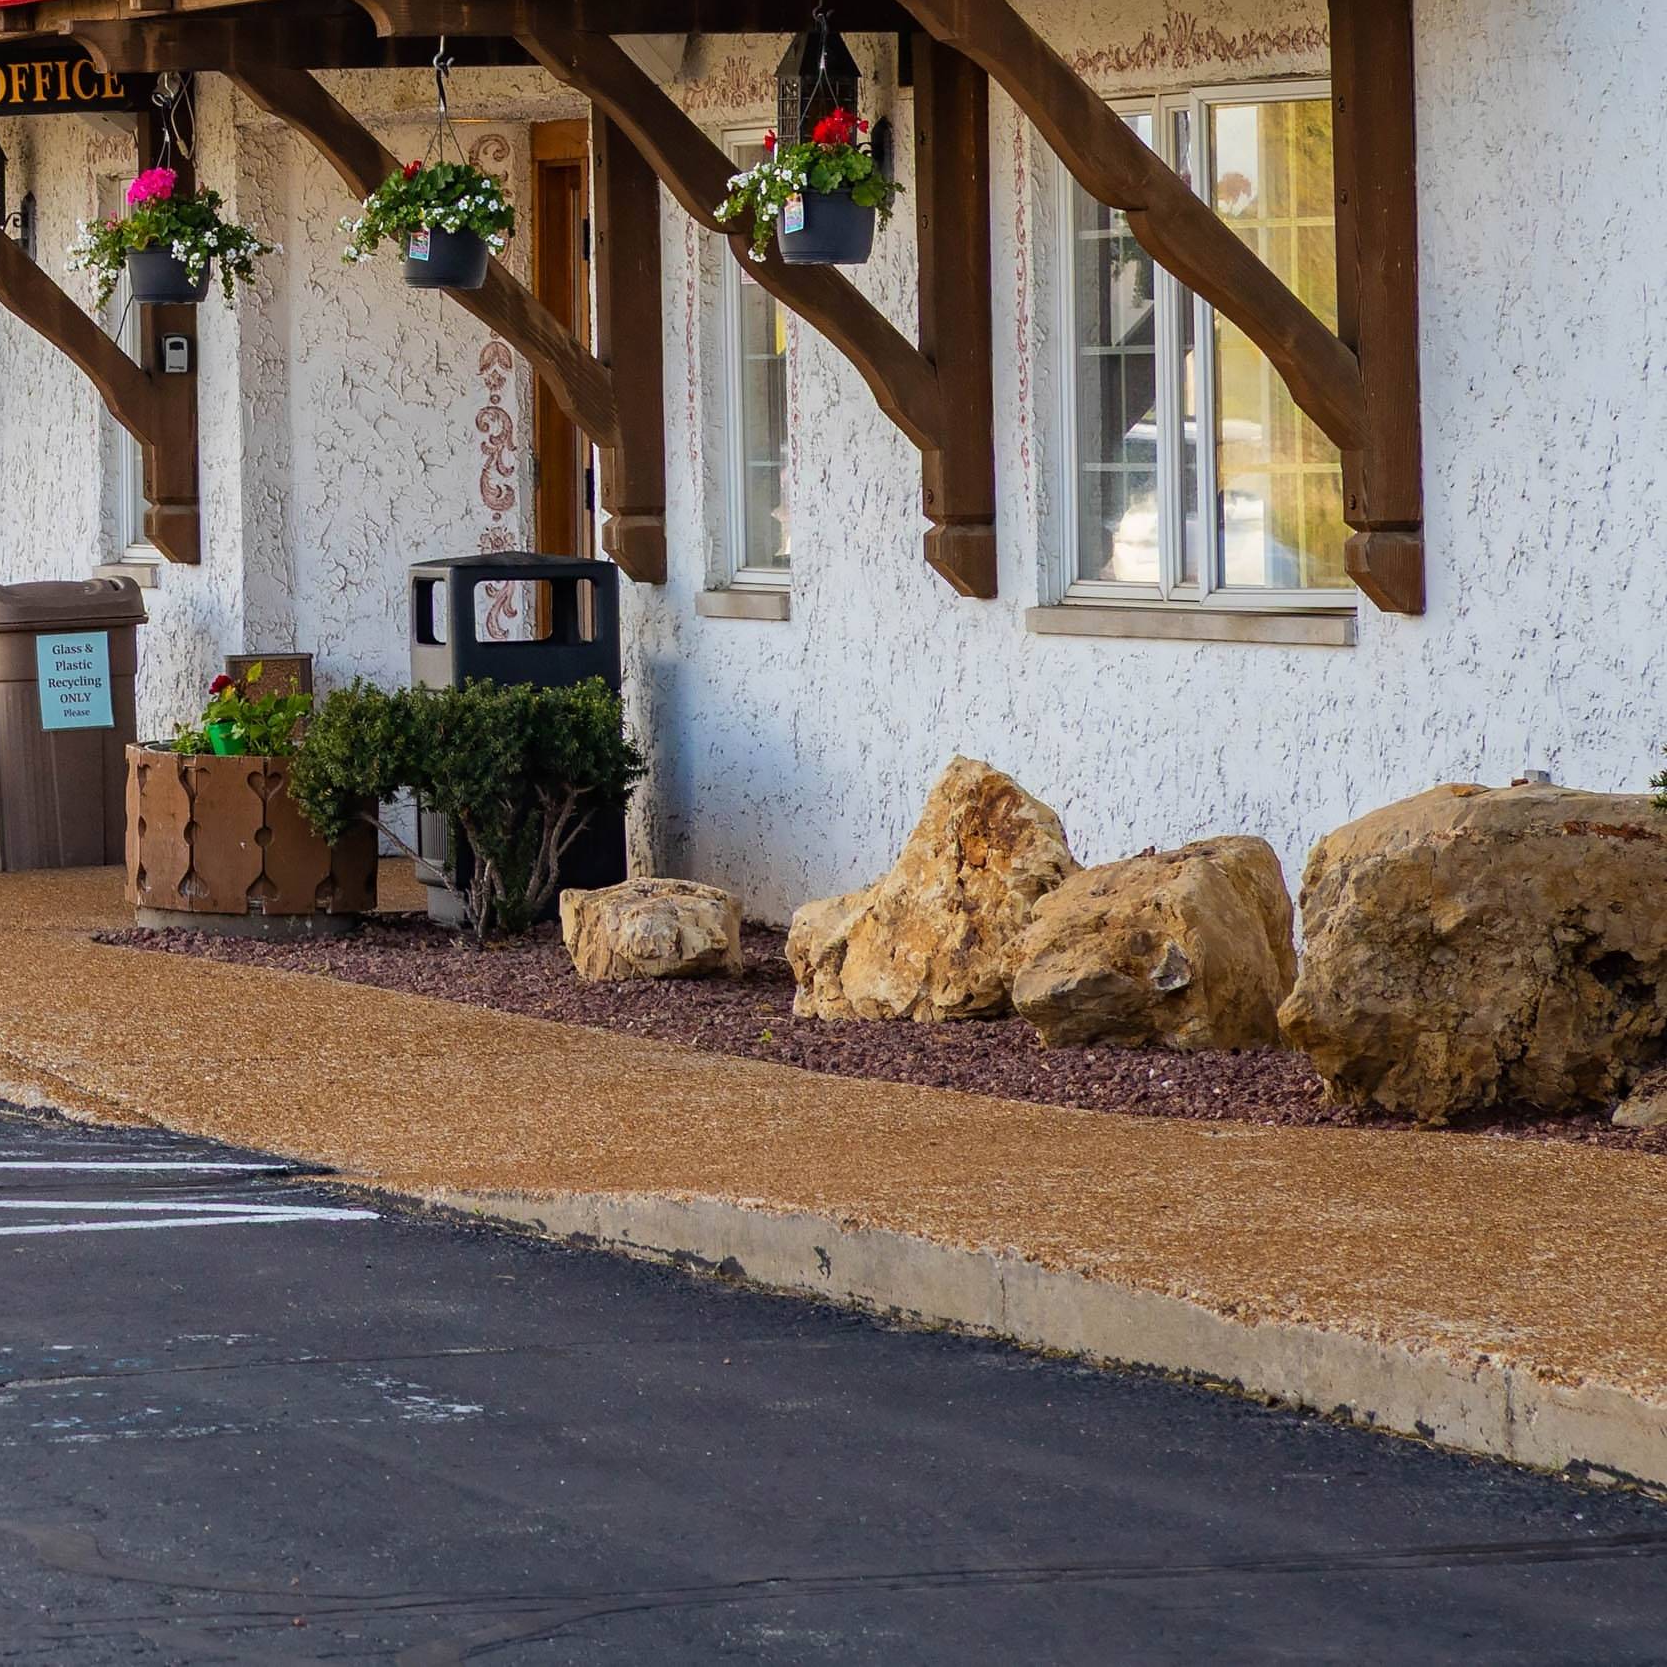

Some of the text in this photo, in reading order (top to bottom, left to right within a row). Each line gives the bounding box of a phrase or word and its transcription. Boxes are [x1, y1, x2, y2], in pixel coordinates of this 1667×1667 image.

[52, 643, 94, 655] Glass &
[55, 659, 93, 671] Plastic
[48, 675, 102, 689] Recycling
[59, 693, 91, 704] ONLY
[63, 708, 91, 718] Please
